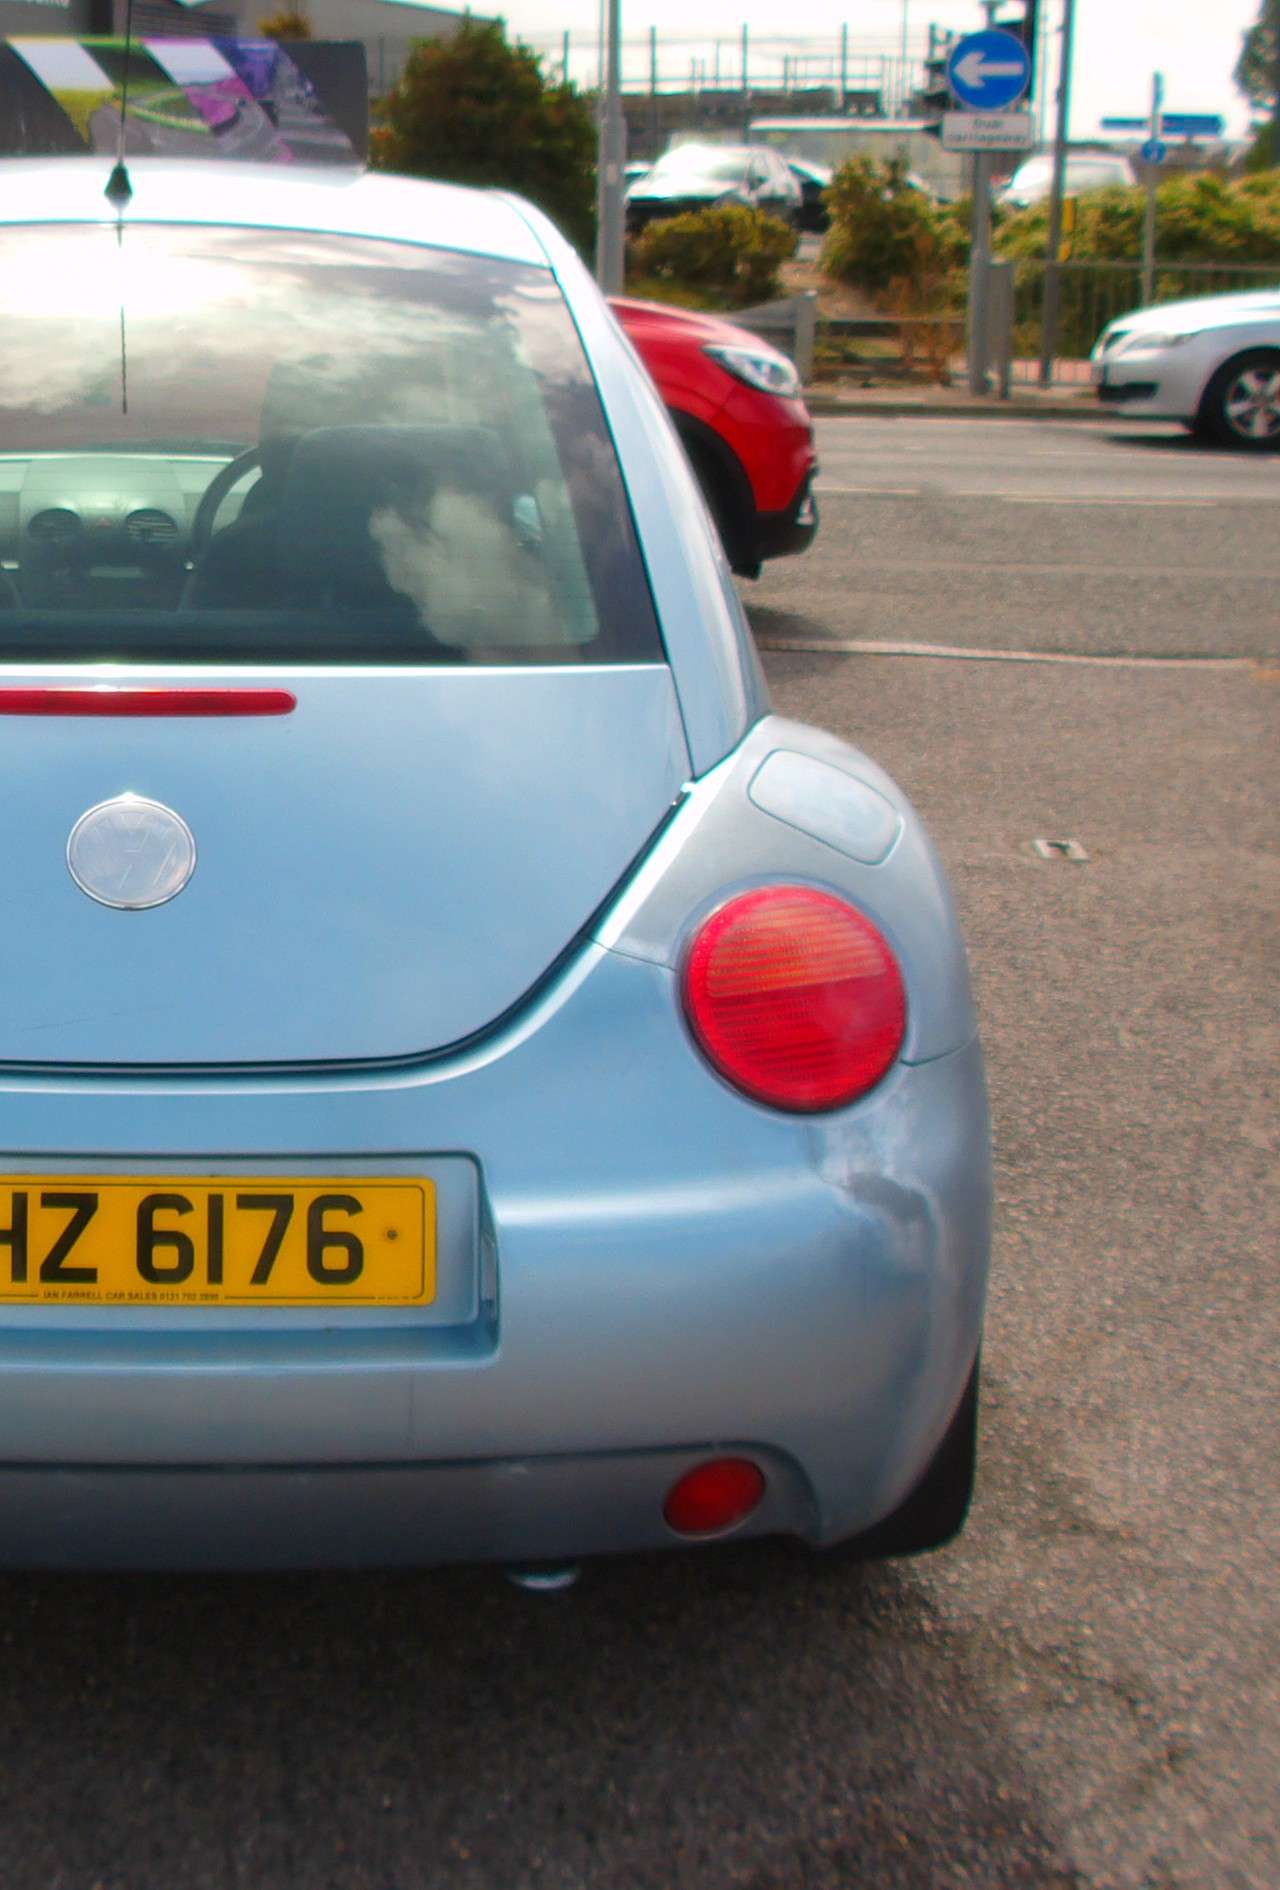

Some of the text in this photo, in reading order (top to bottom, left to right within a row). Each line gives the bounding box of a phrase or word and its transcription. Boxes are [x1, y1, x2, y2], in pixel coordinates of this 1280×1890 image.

[135, 1193, 365, 1286] 6176
[106, 1291, 125, 1300] CAR
[127, 1291, 158, 1300] SALES
